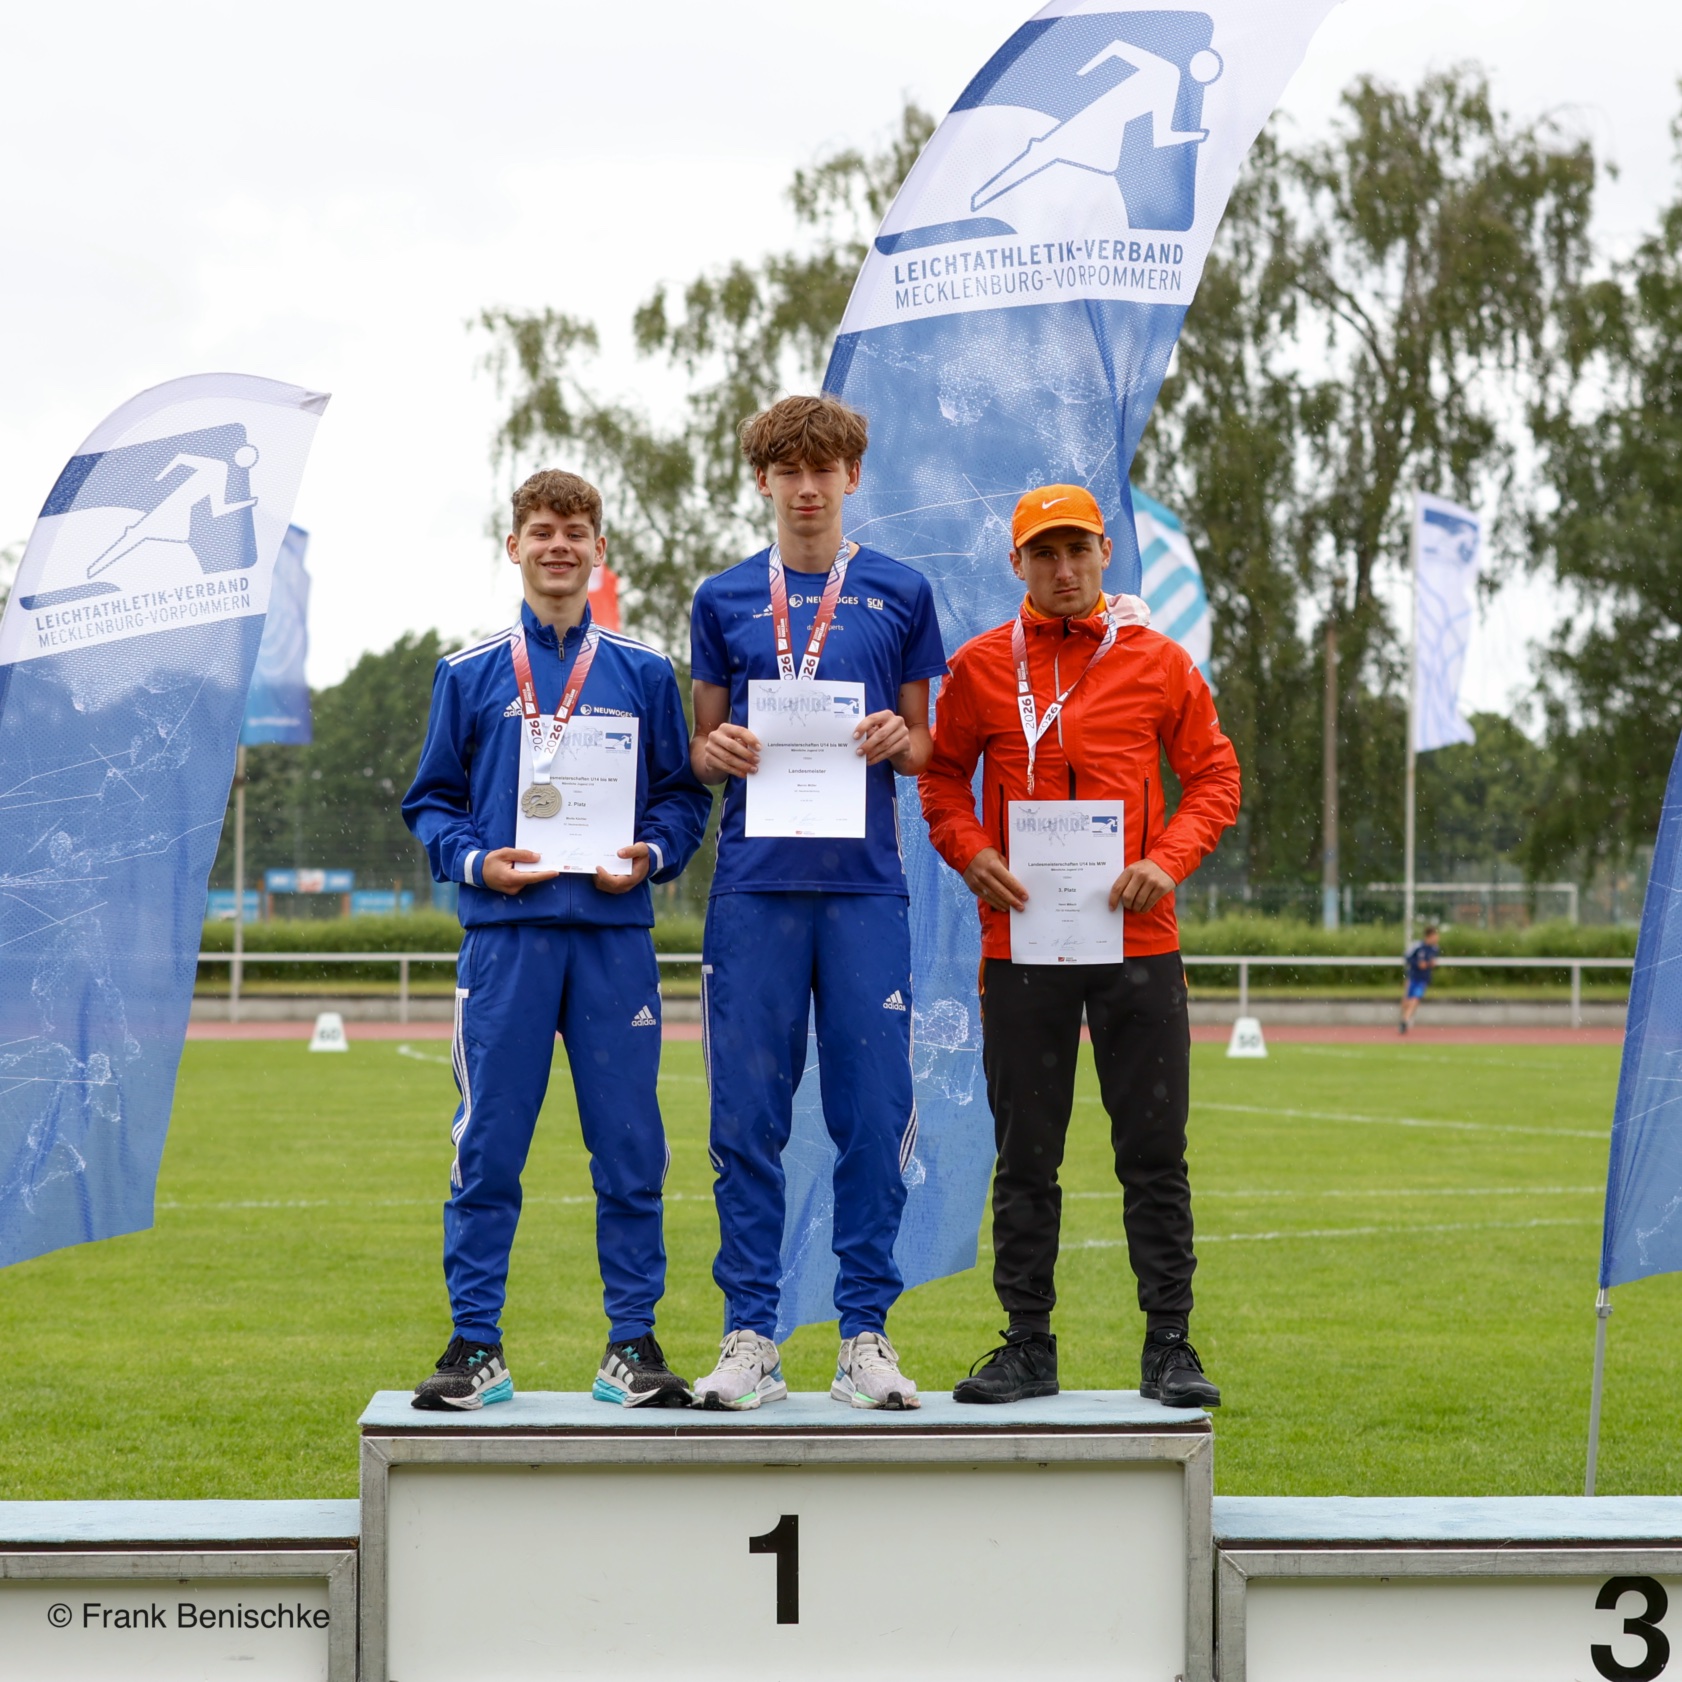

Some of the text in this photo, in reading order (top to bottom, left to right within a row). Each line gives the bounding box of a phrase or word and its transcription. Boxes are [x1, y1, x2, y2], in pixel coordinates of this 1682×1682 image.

[894, 239, 1183, 284] LEICHTATHLETIK-VERBAND
[895, 265, 1181, 310] MECKLENBURG-VORPOMMERN
[36, 577, 249, 631] LEICHTATHLETIK-VERBAND
[806, 596, 859, 605] NEOGES
[38, 593, 250, 648] MECKLENBURG-VORPOMMERN
[781, 656, 794, 680] 026
[801, 659, 816, 680] 026
[593, 706, 633, 718] NEUWOGES
[756, 697, 831, 712] URKUNDE
[1022, 698, 1035, 729] 2026
[1039, 706, 1058, 734] 2026
[529, 720, 543, 752] 2026
[544, 724, 563, 754] 2026
[1016, 817, 1090, 832] URKUNDE
[883, 1002, 906, 1012] adidas
[631, 1018, 656, 1027] adidas
[749, 1514, 799, 1625] 1
[1590, 1575, 1671, 1682] 3
